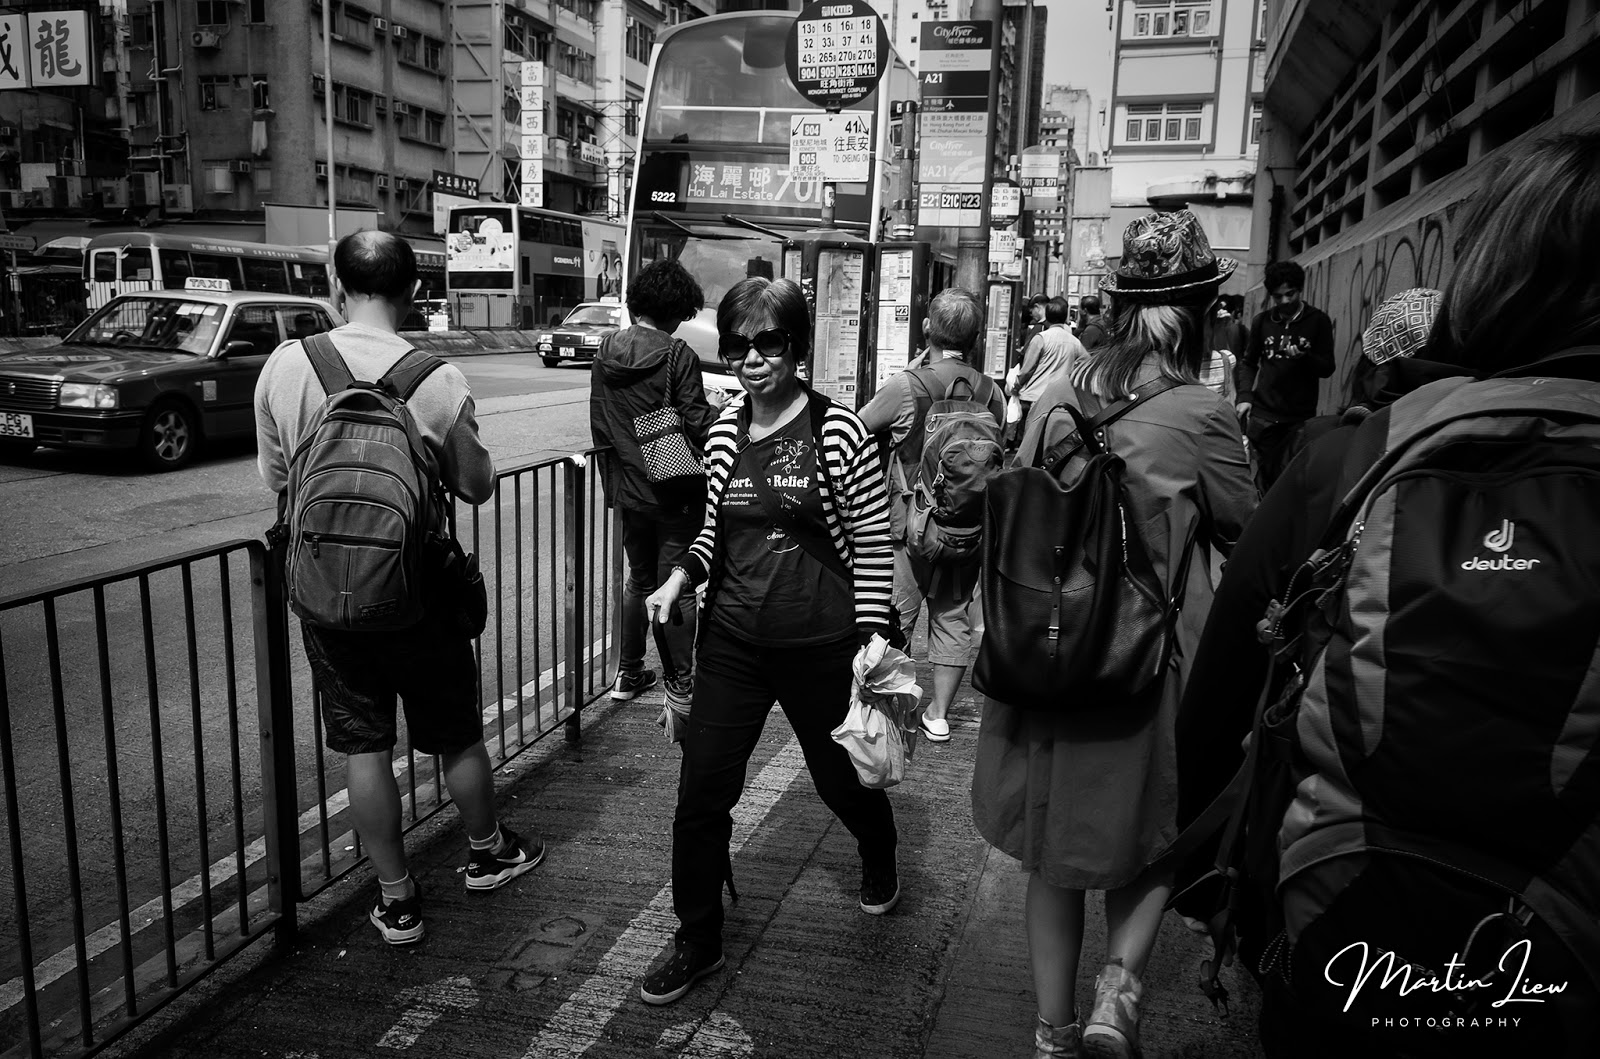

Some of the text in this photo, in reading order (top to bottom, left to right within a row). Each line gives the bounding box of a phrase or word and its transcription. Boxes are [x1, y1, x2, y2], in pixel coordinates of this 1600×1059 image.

[822, 22, 832, 33] 16
[861, 19, 871, 30] 18
[804, 38, 813, 49] 32
[842, 36, 851, 46] 37
[860, 34, 873, 45] 41A
[801, 68, 816, 79] 904
[820, 67, 836, 78] 905
[838, 65, 856, 77] N283
[924, 73, 943, 83] A21
[804, 124, 820, 136] 904
[833, 136, 868, 152] 往長安
[800, 153, 816, 164] 905
[693, 164, 771, 188] 海麗邨
[651, 191, 676, 202] 5222
[687, 183, 773, 201] Hoi Lai Estate
[920, 194, 939, 207] E21
[941, 194, 959, 207] E21C
[189, 279, 222, 289] TAXI
[6, 413, 21, 425] PG
[773, 474, 810, 488] Relief
[1461, 553, 1541, 571] deuter
